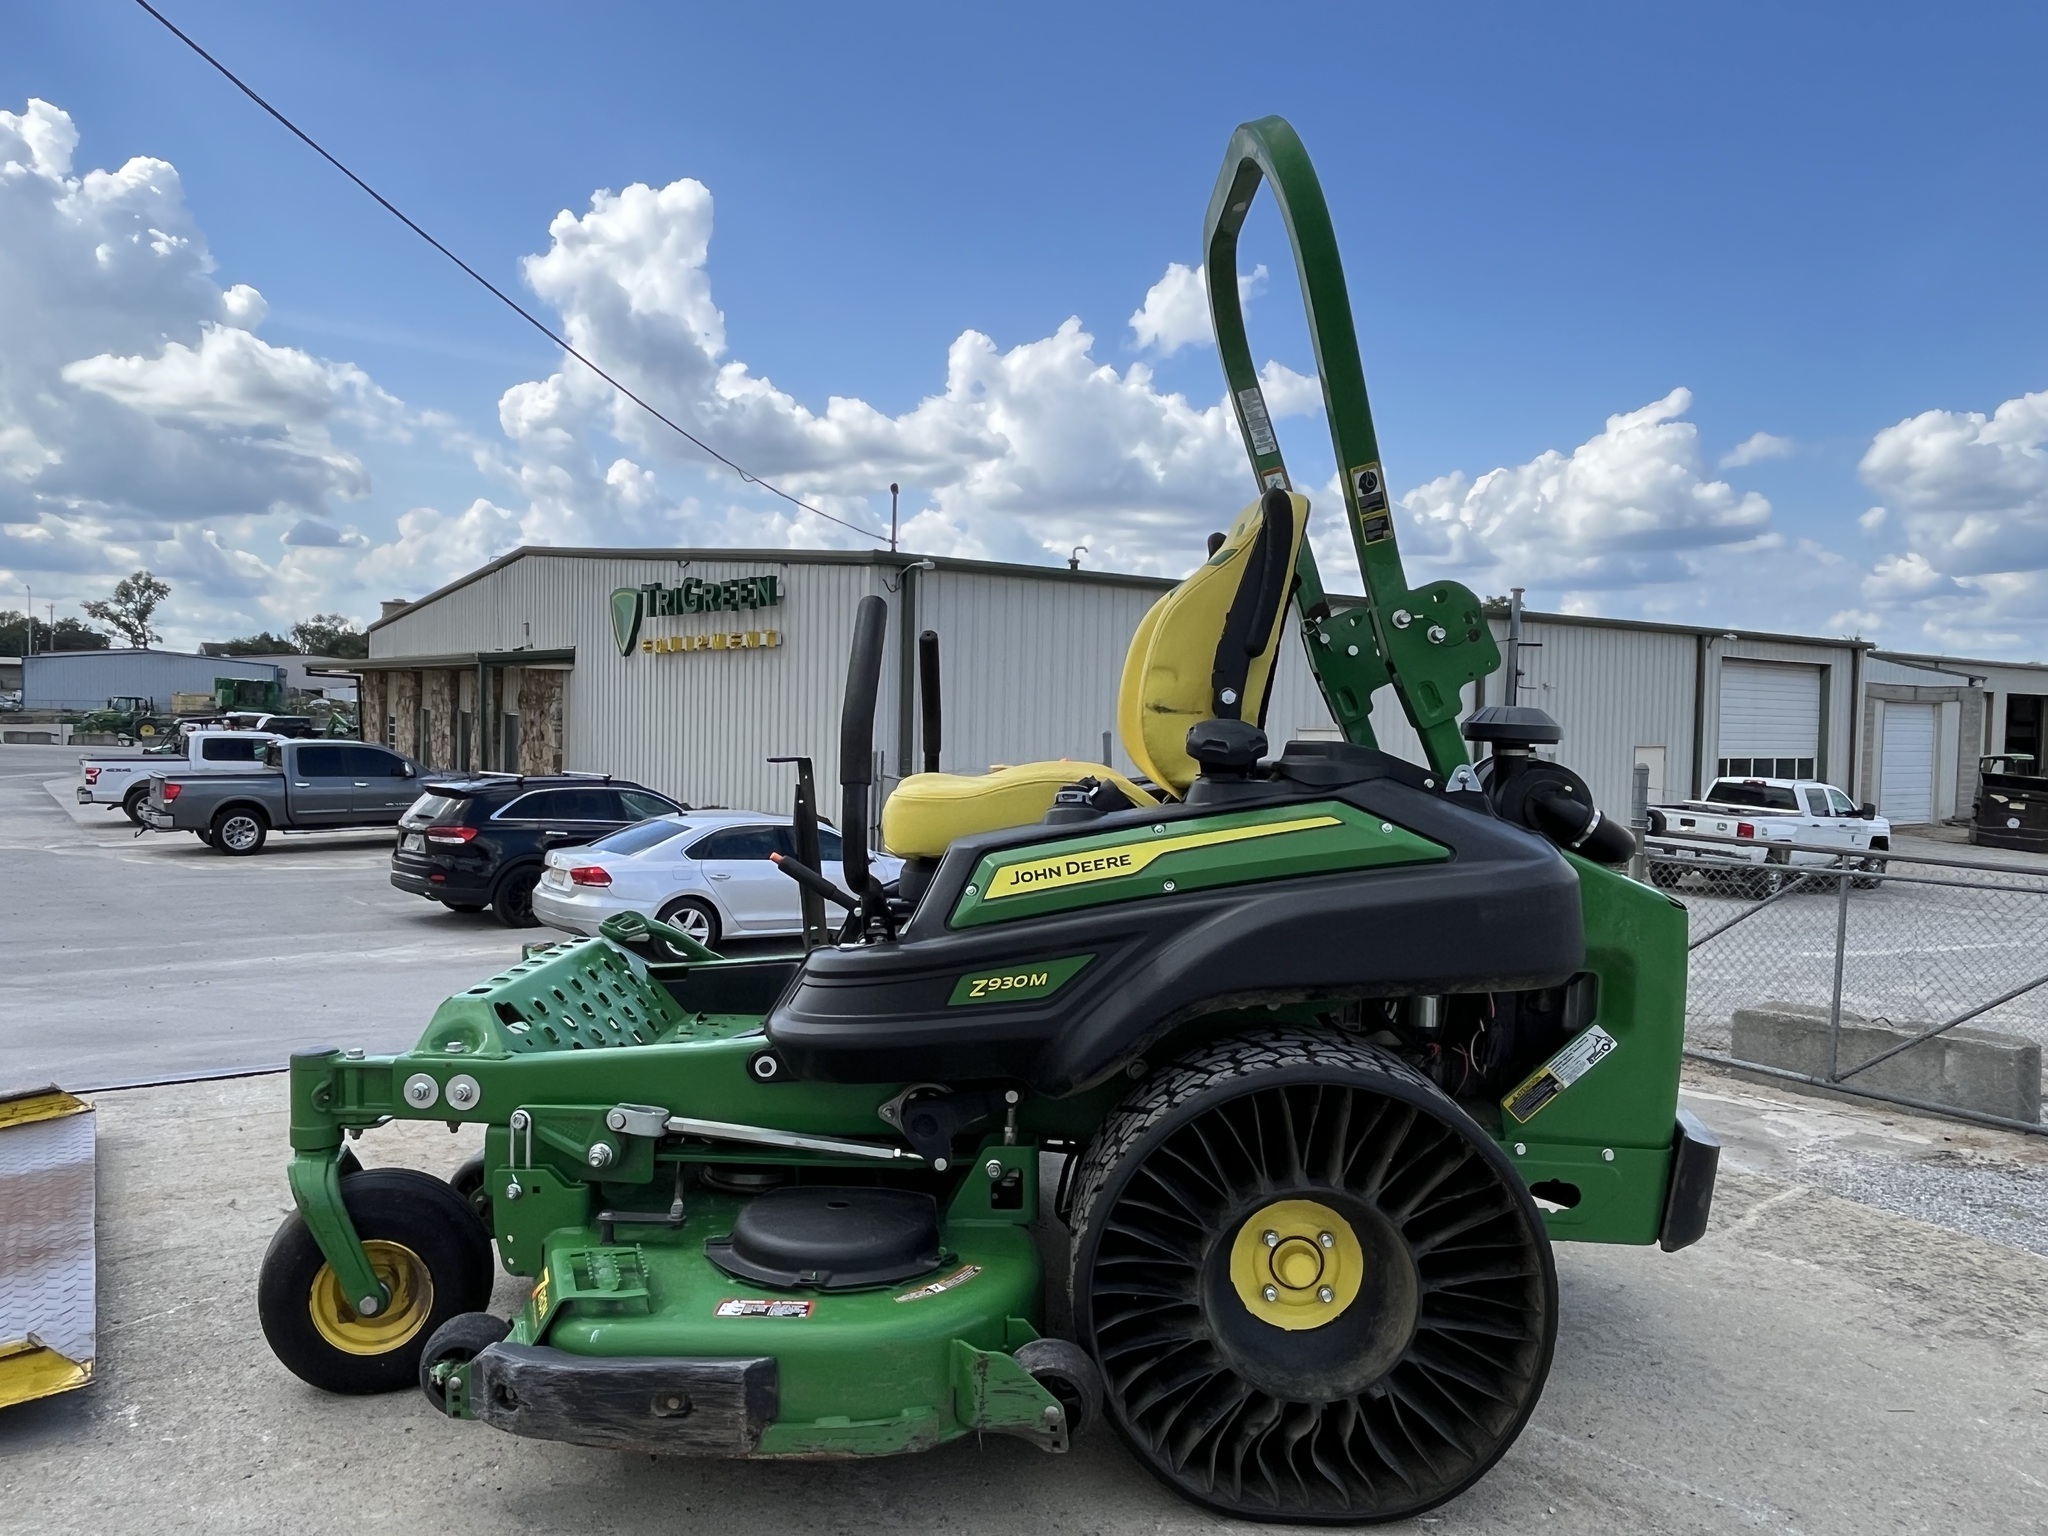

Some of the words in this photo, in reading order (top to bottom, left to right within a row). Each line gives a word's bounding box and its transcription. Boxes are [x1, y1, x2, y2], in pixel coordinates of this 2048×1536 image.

[641, 575, 778, 617] TRIGREEN
[1010, 866, 1061, 886] JOHN
[1066, 854, 1132, 876] DEERE
[969, 973, 1048, 997] Z930M
